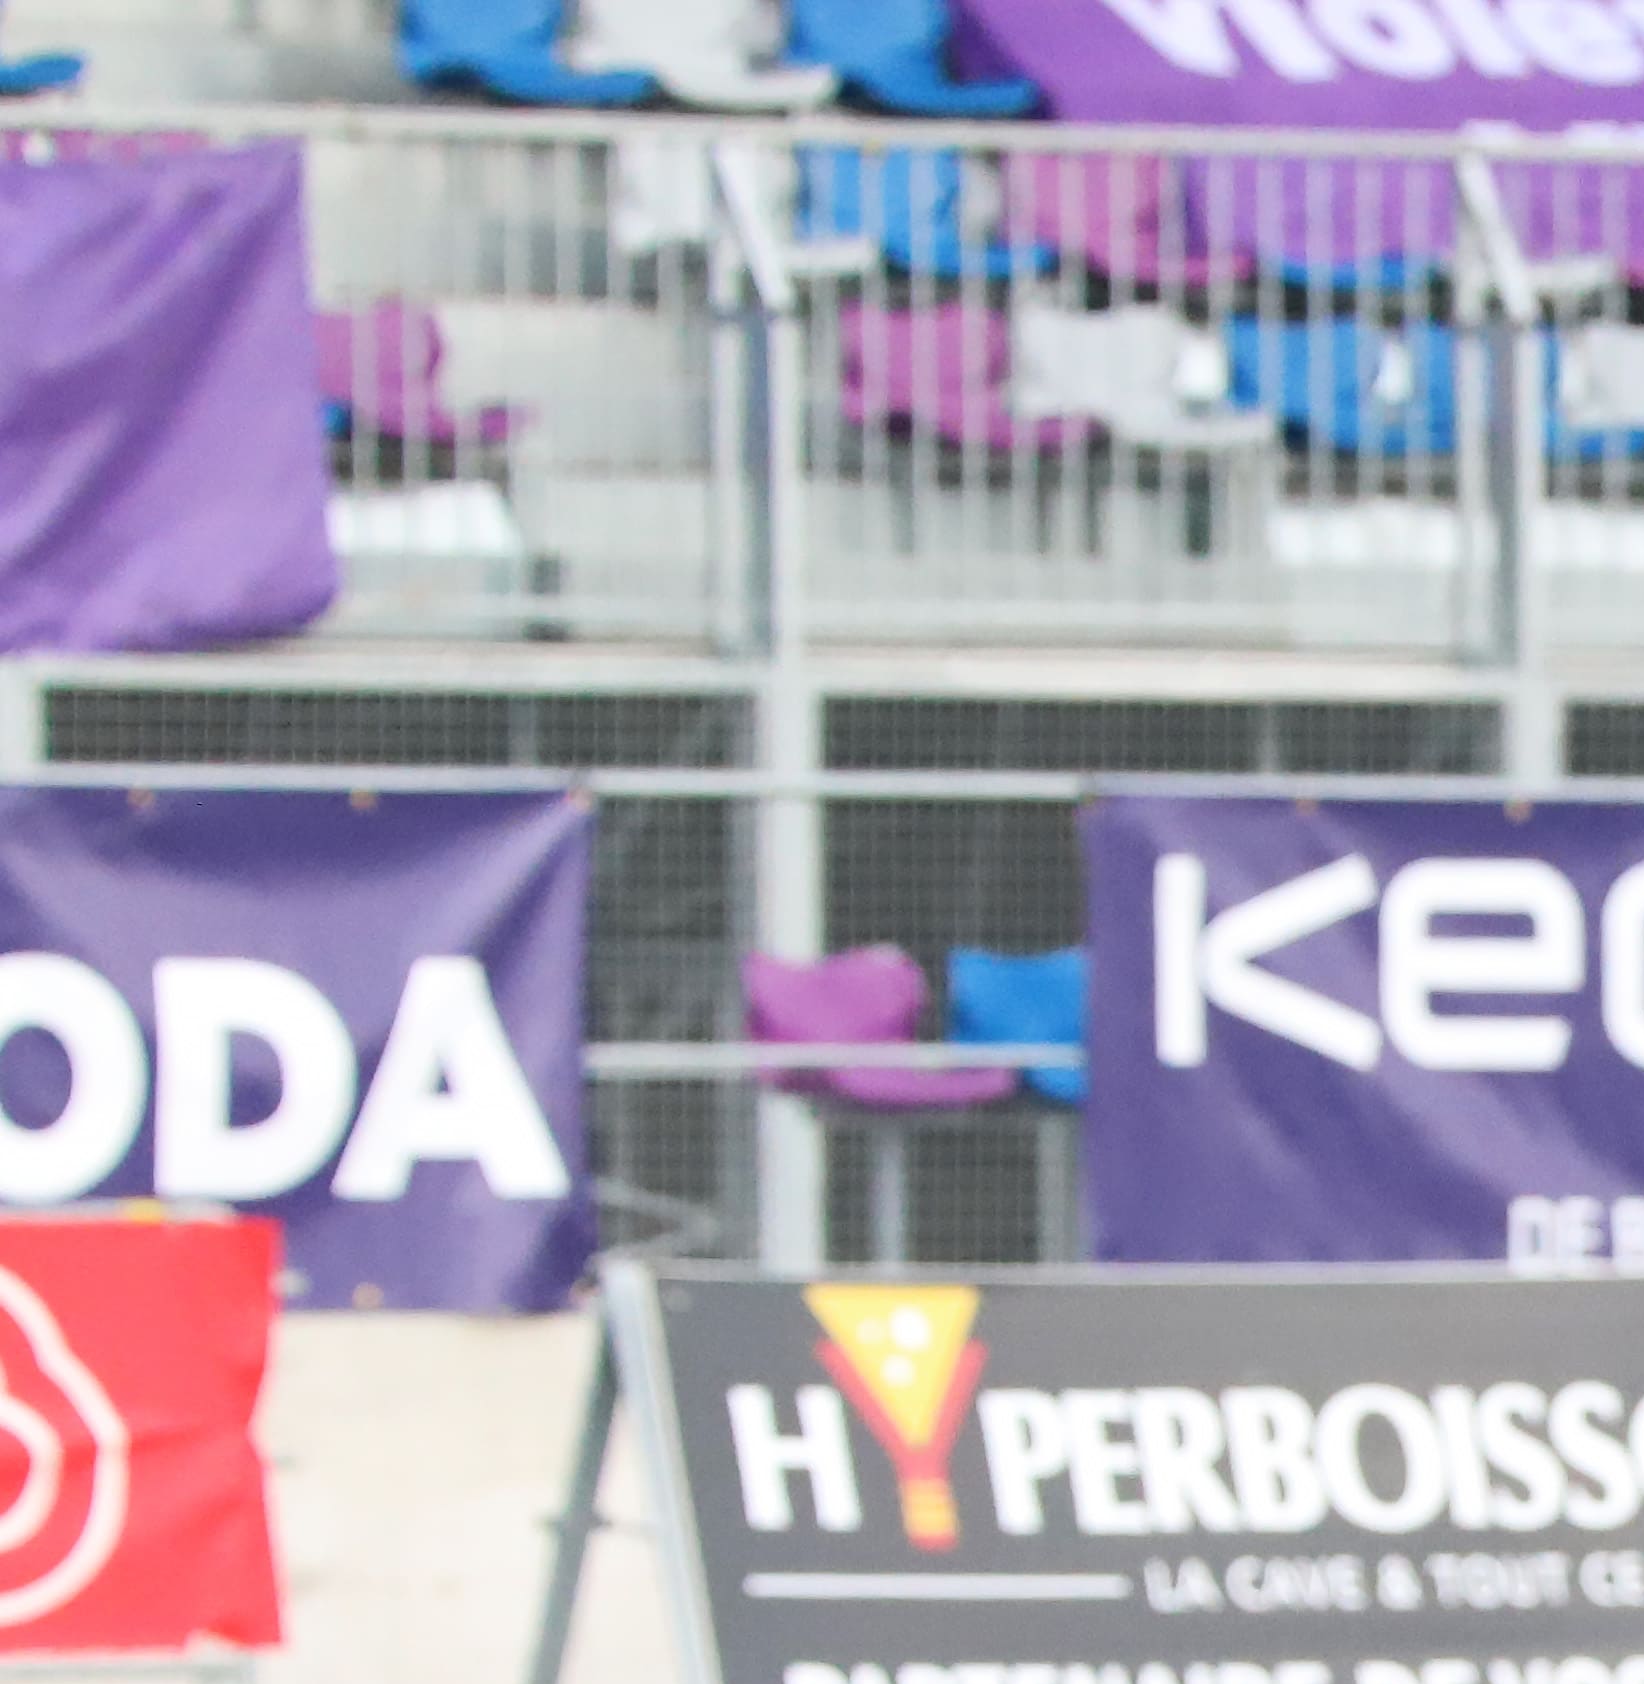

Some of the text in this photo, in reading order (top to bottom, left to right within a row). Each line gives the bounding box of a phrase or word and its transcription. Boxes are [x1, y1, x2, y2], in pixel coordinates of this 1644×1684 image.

[1507, 1196, 1602, 1275] DE
[1142, 1557, 1224, 1614] LA
[1225, 1553, 1366, 1612] CAVE
[1424, 1548, 1570, 1609] TOUT
